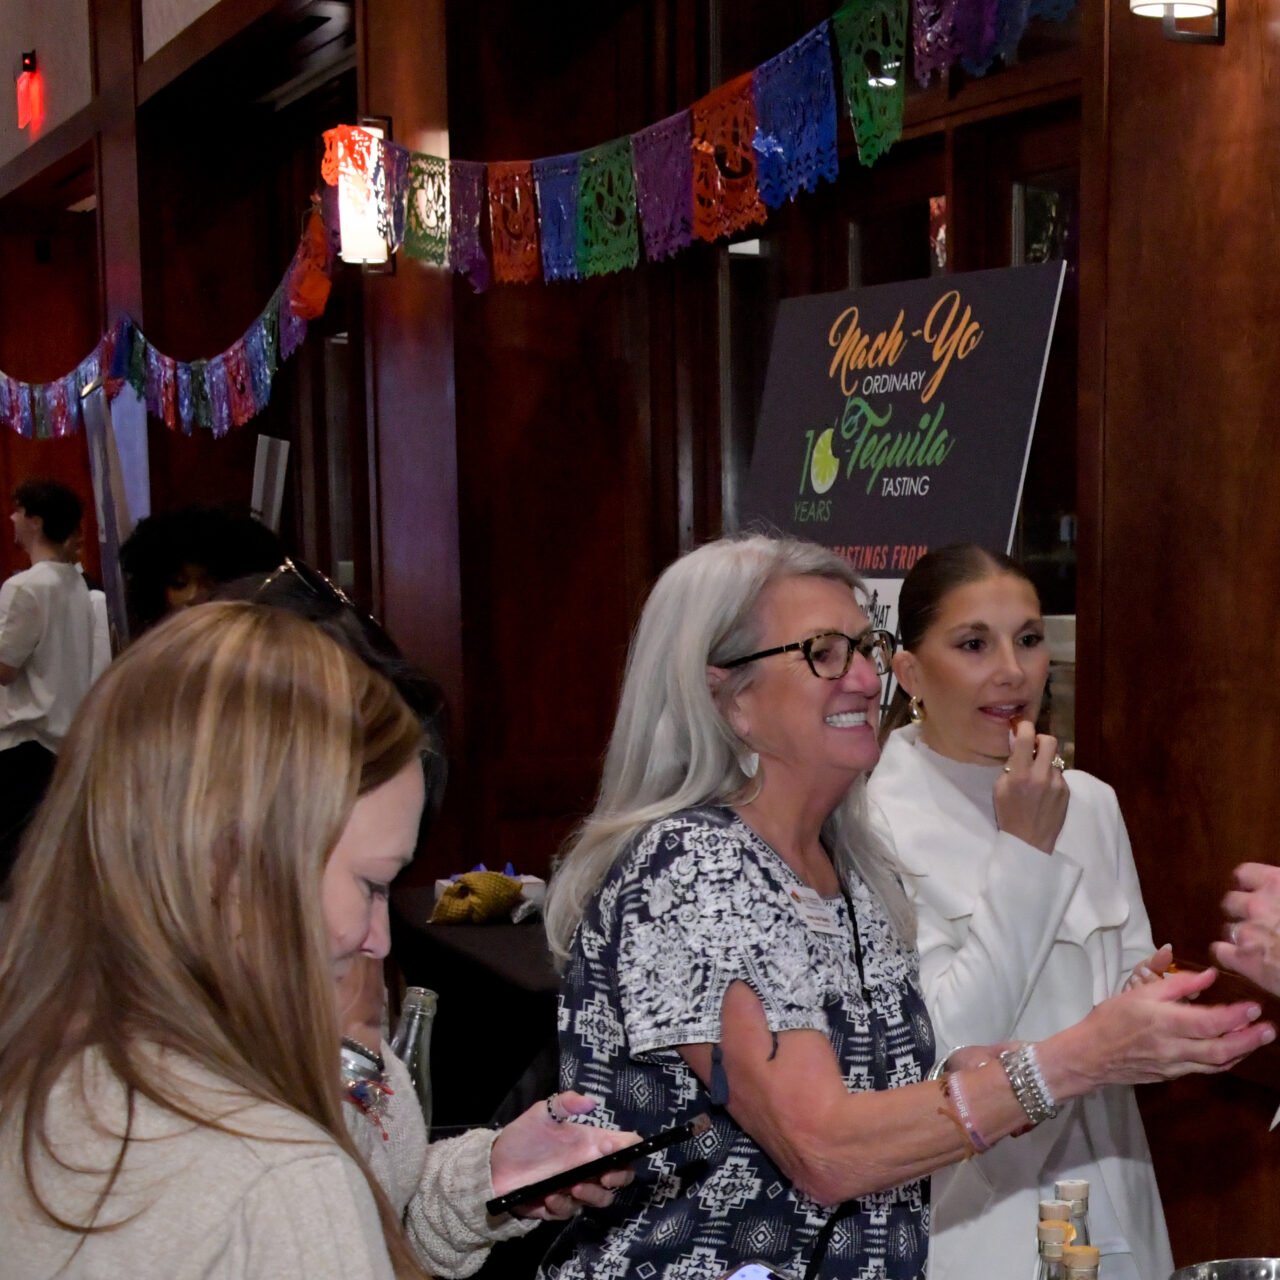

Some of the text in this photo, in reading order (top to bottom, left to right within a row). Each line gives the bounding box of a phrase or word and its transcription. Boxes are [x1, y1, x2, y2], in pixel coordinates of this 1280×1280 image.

[863, 370, 925, 395] ORDINARY
[841, 397, 955, 494] Tequila
[882, 476, 930, 497] TASTING
[794, 500, 832, 522] YEARS
